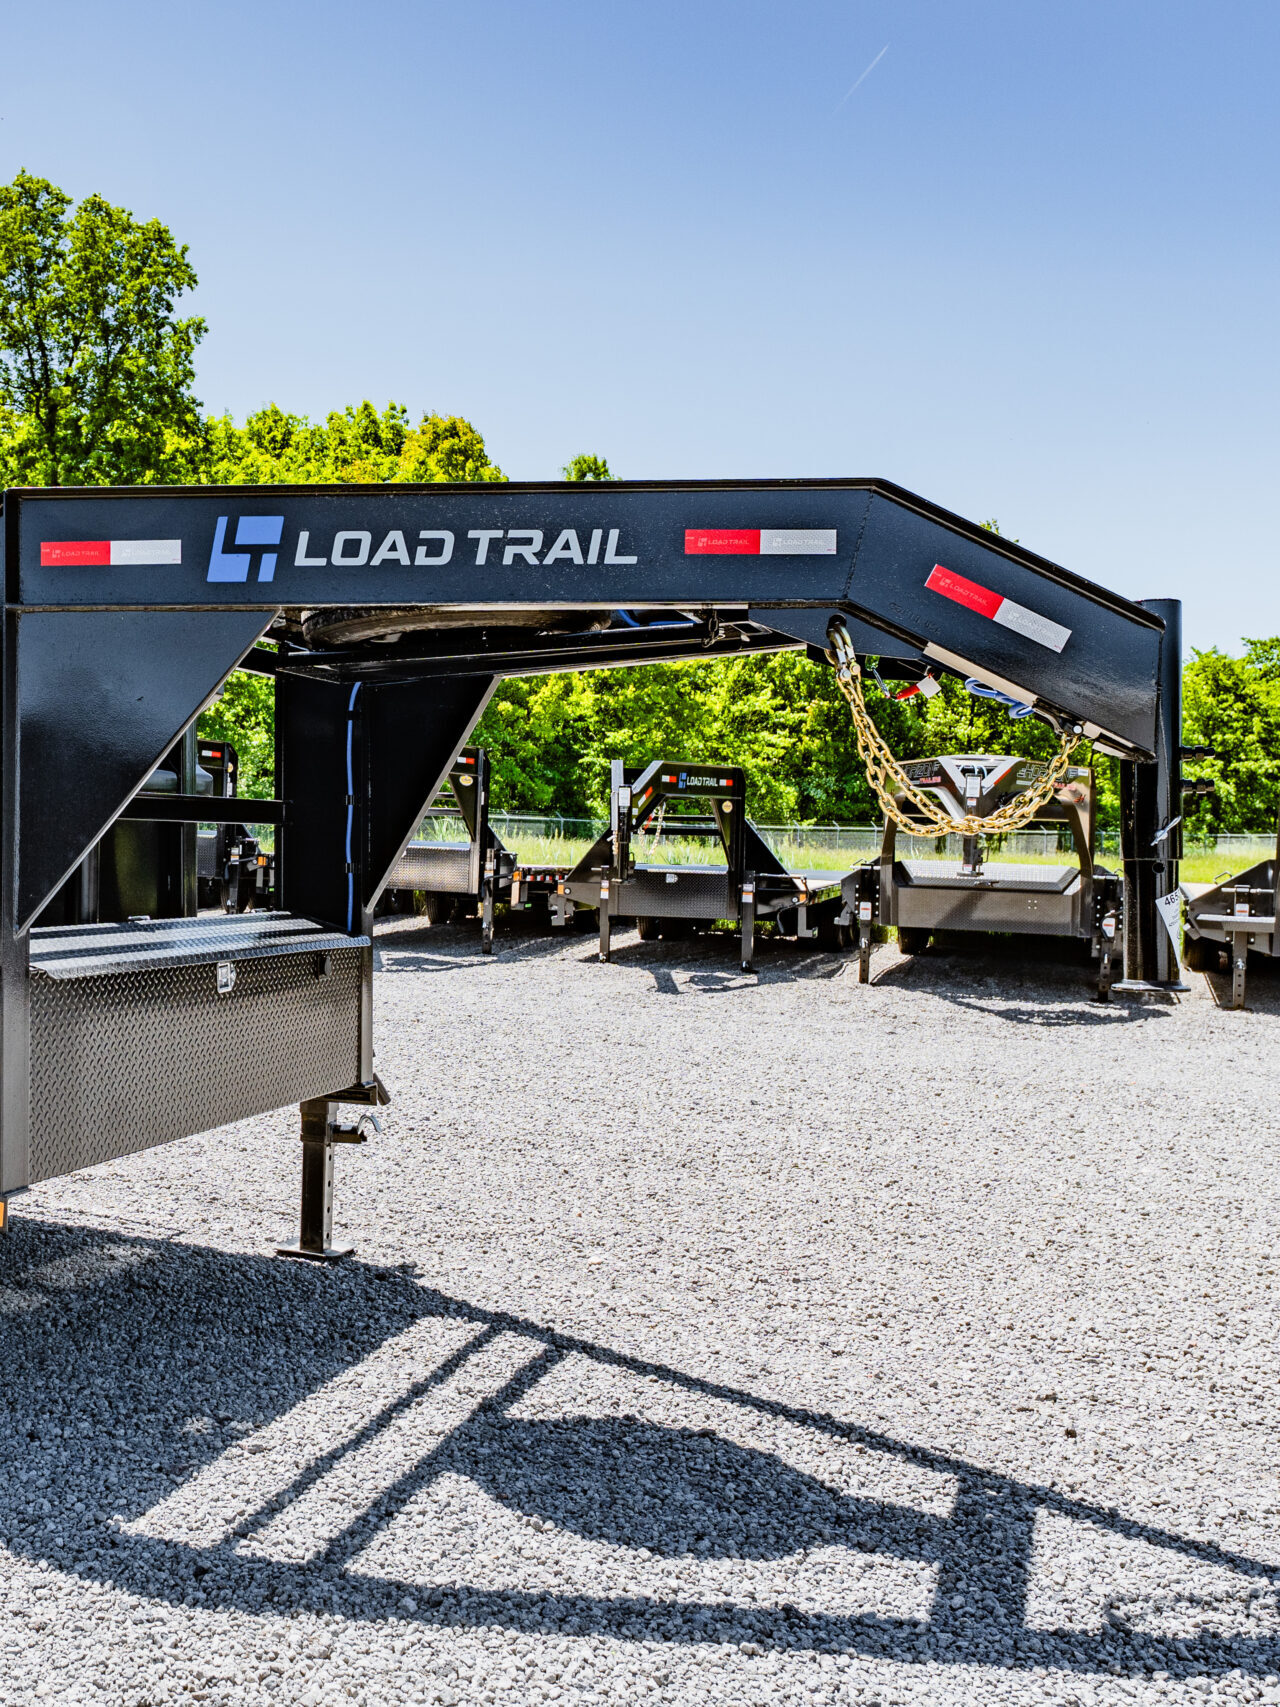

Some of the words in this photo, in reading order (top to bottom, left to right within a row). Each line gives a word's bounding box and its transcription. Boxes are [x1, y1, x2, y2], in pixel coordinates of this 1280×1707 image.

[294, 530, 455, 566] LOAD
[467, 528, 638, 565] TRAIL
[686, 776, 703, 786] LOAD
[703, 777, 718, 787] TRAIL
